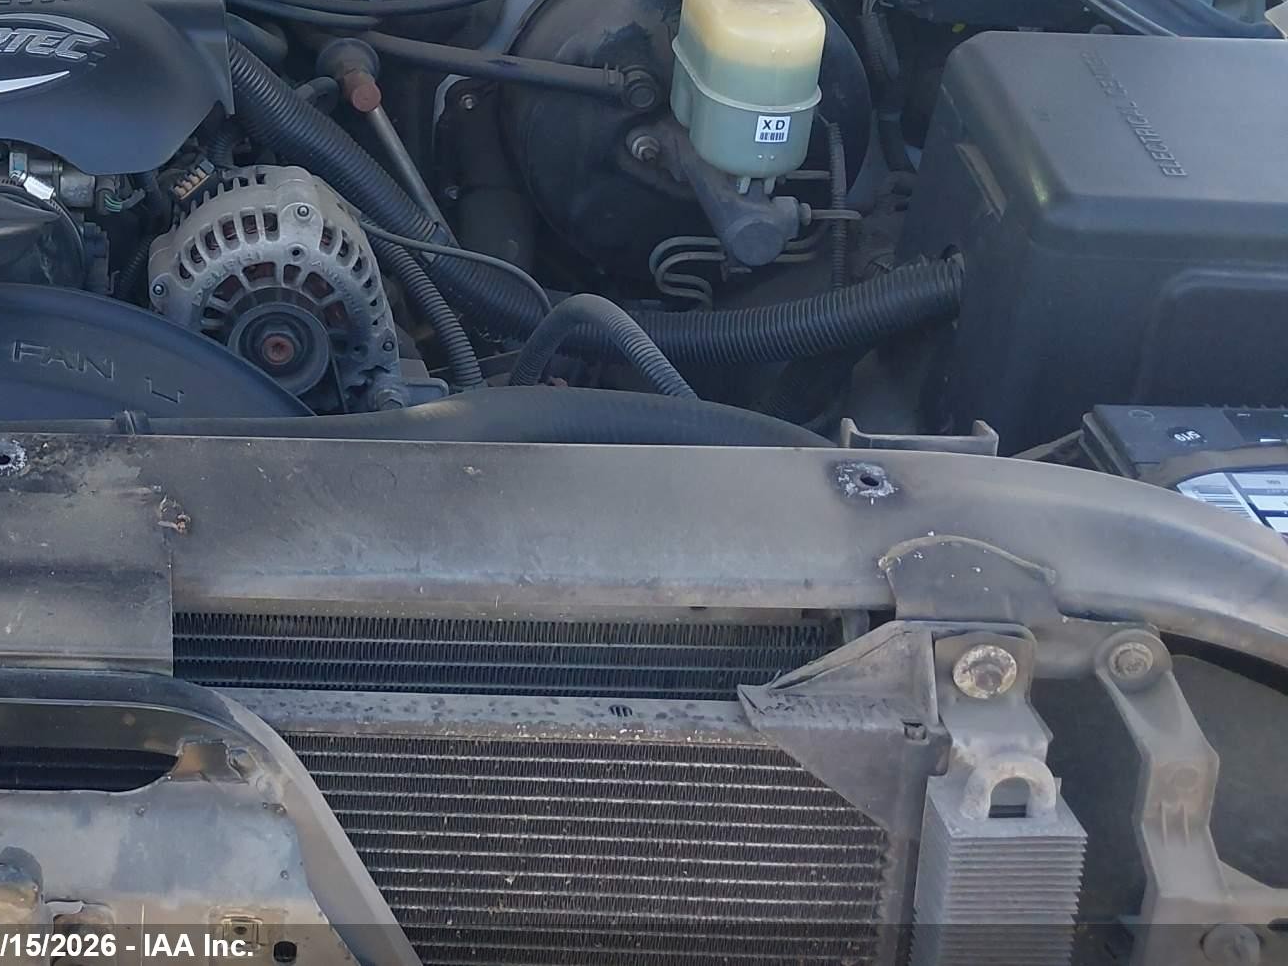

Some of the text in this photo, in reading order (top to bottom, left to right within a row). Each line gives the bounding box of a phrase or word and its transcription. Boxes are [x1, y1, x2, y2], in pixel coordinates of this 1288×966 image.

[762, 119, 785, 130] X D
[12, 338, 114, 380] FAN
